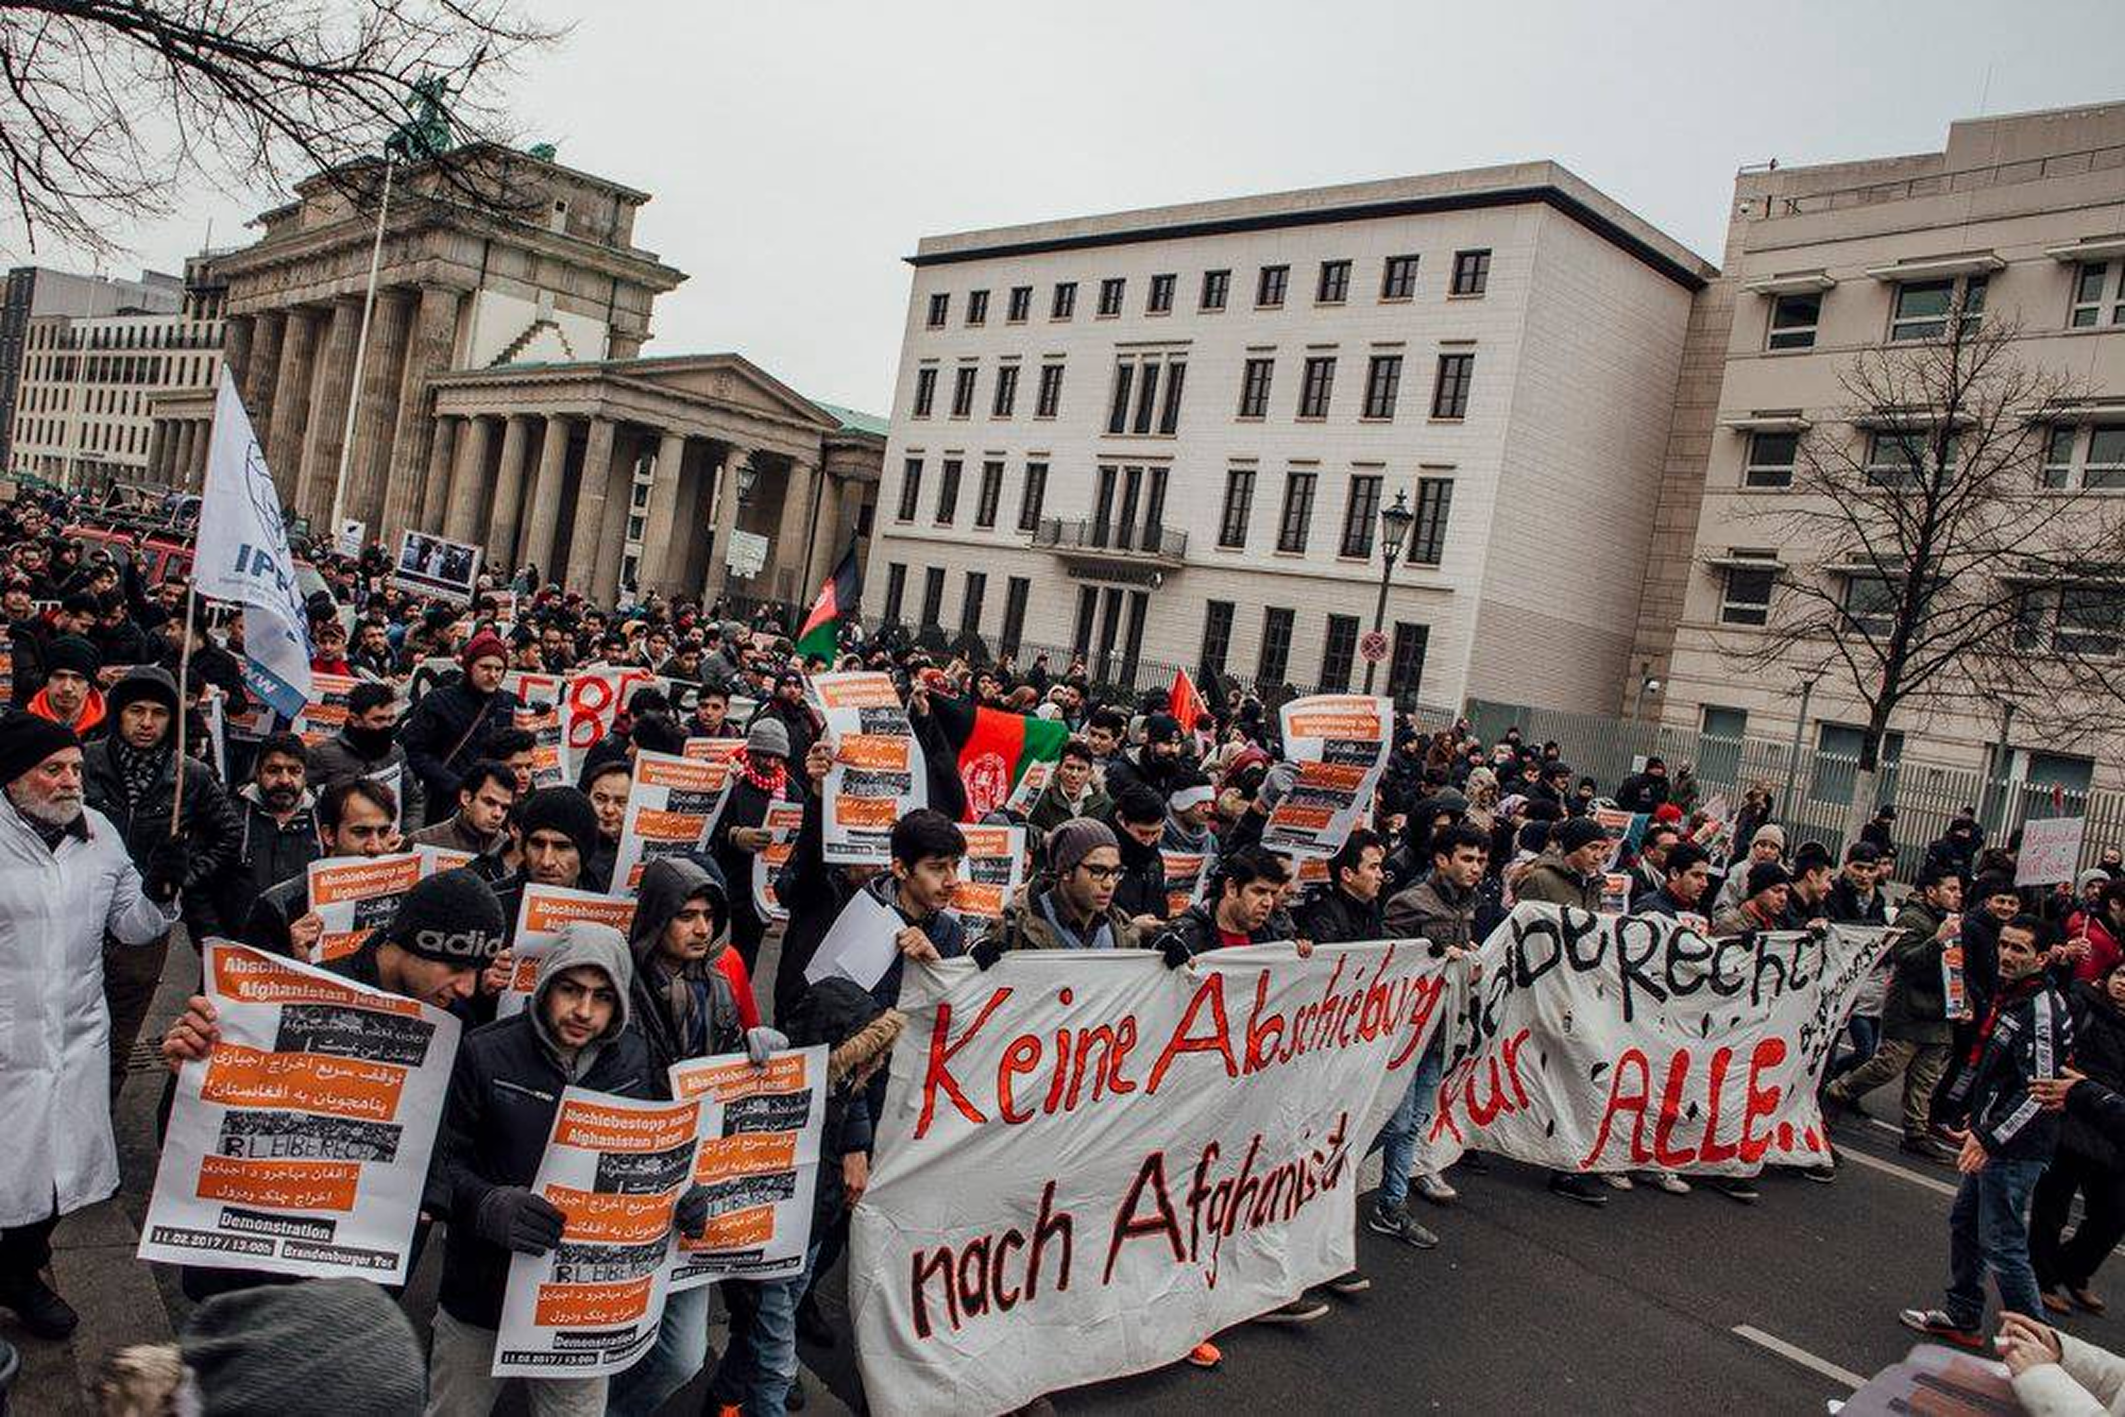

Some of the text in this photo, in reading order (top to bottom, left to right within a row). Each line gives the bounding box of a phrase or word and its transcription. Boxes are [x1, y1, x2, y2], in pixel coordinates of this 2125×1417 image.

[238, 980, 347, 1003] Afghanistan
[913, 986, 1137, 1140] Keine
[221, 1212, 331, 1240] Demonstration
[911, 1179, 1074, 1339] nach
